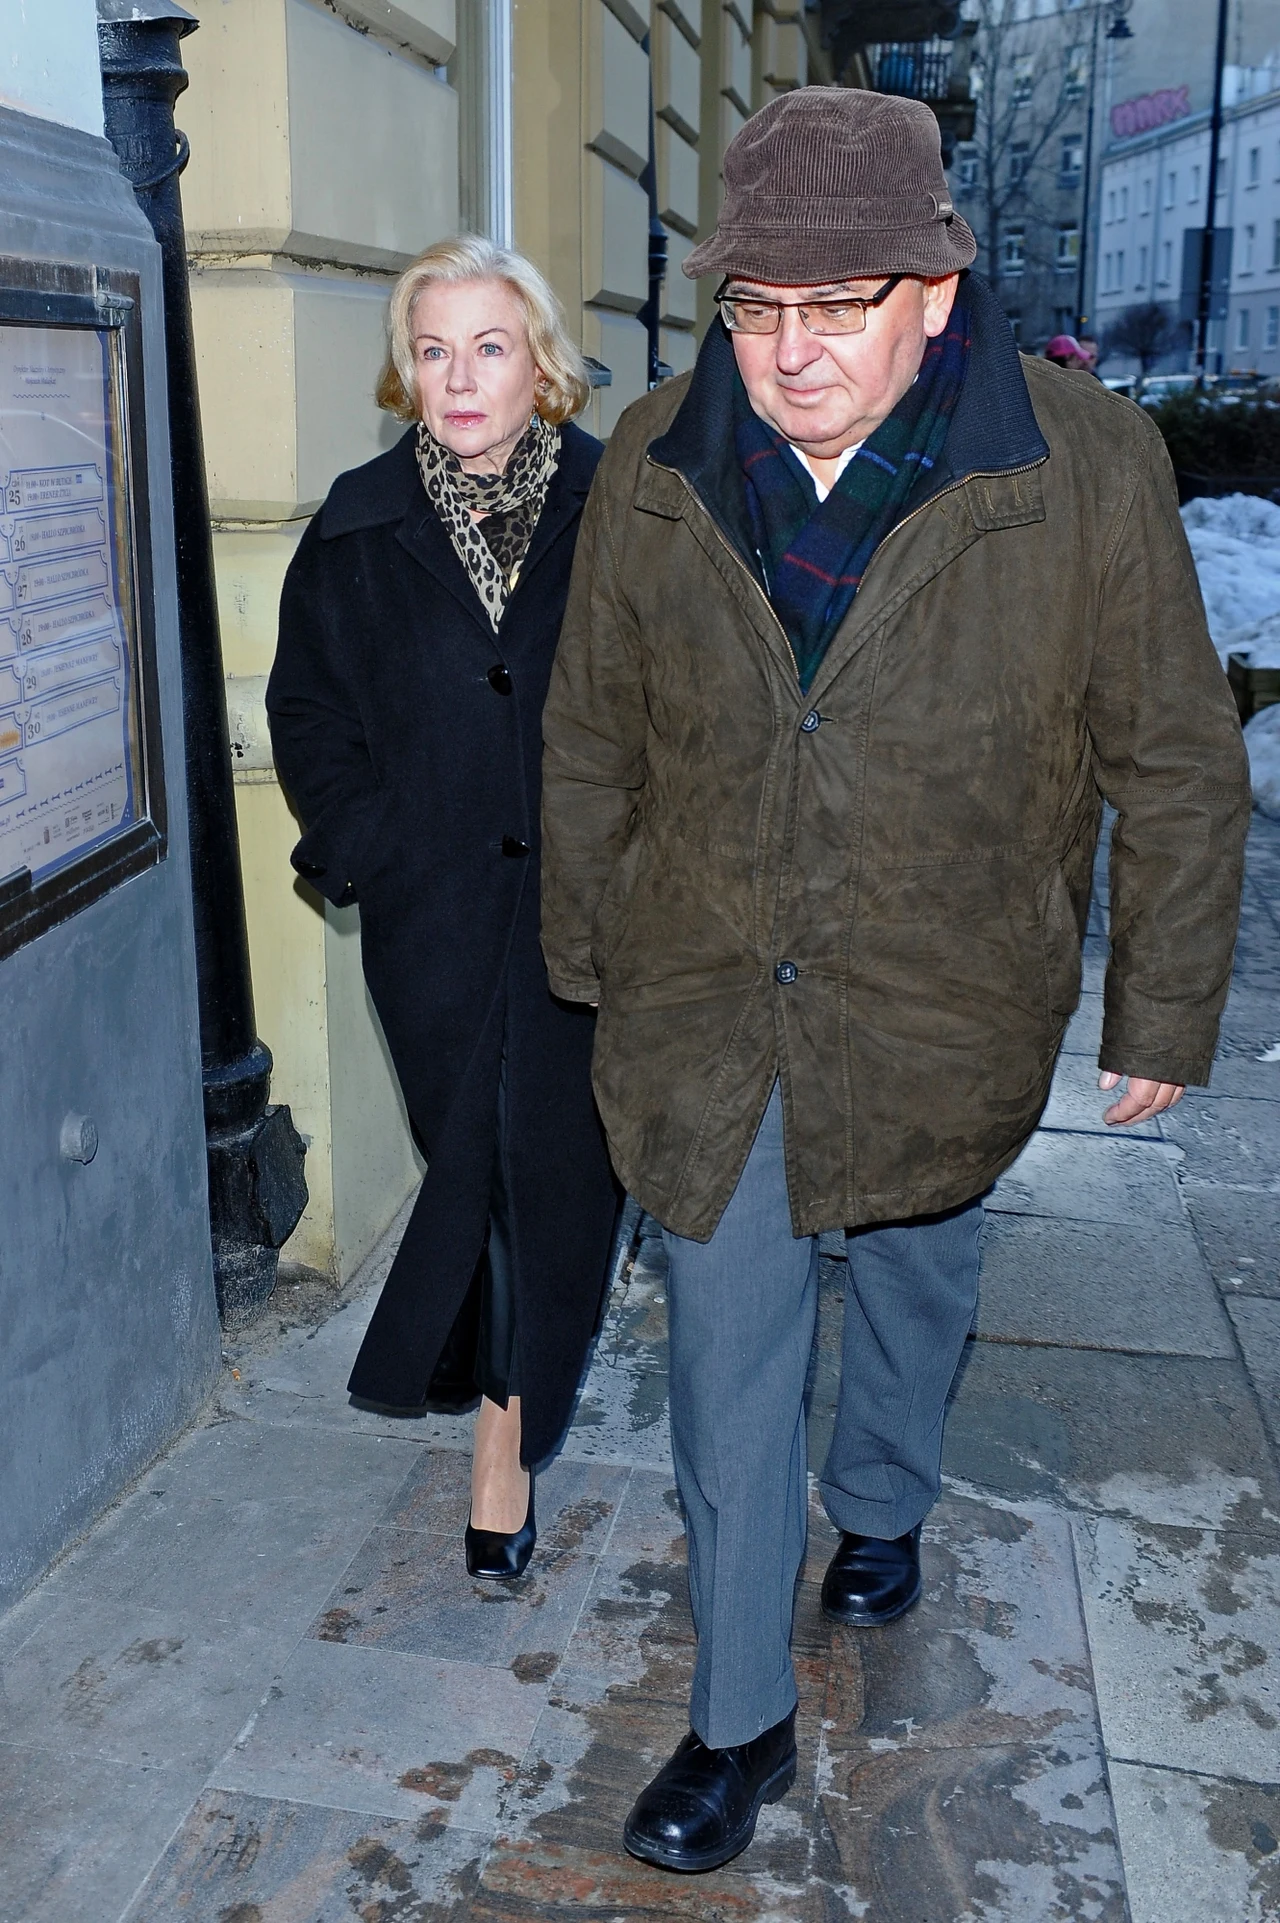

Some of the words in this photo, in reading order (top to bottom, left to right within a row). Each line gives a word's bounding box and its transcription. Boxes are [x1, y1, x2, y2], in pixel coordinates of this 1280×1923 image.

[8, 490, 21, 506] 25
[14, 535, 26, 552] 26
[18, 584, 27, 600] 27
[21, 629, 32, 646] 28
[26, 676, 36, 691] 29
[28, 721, 41, 739] 30
